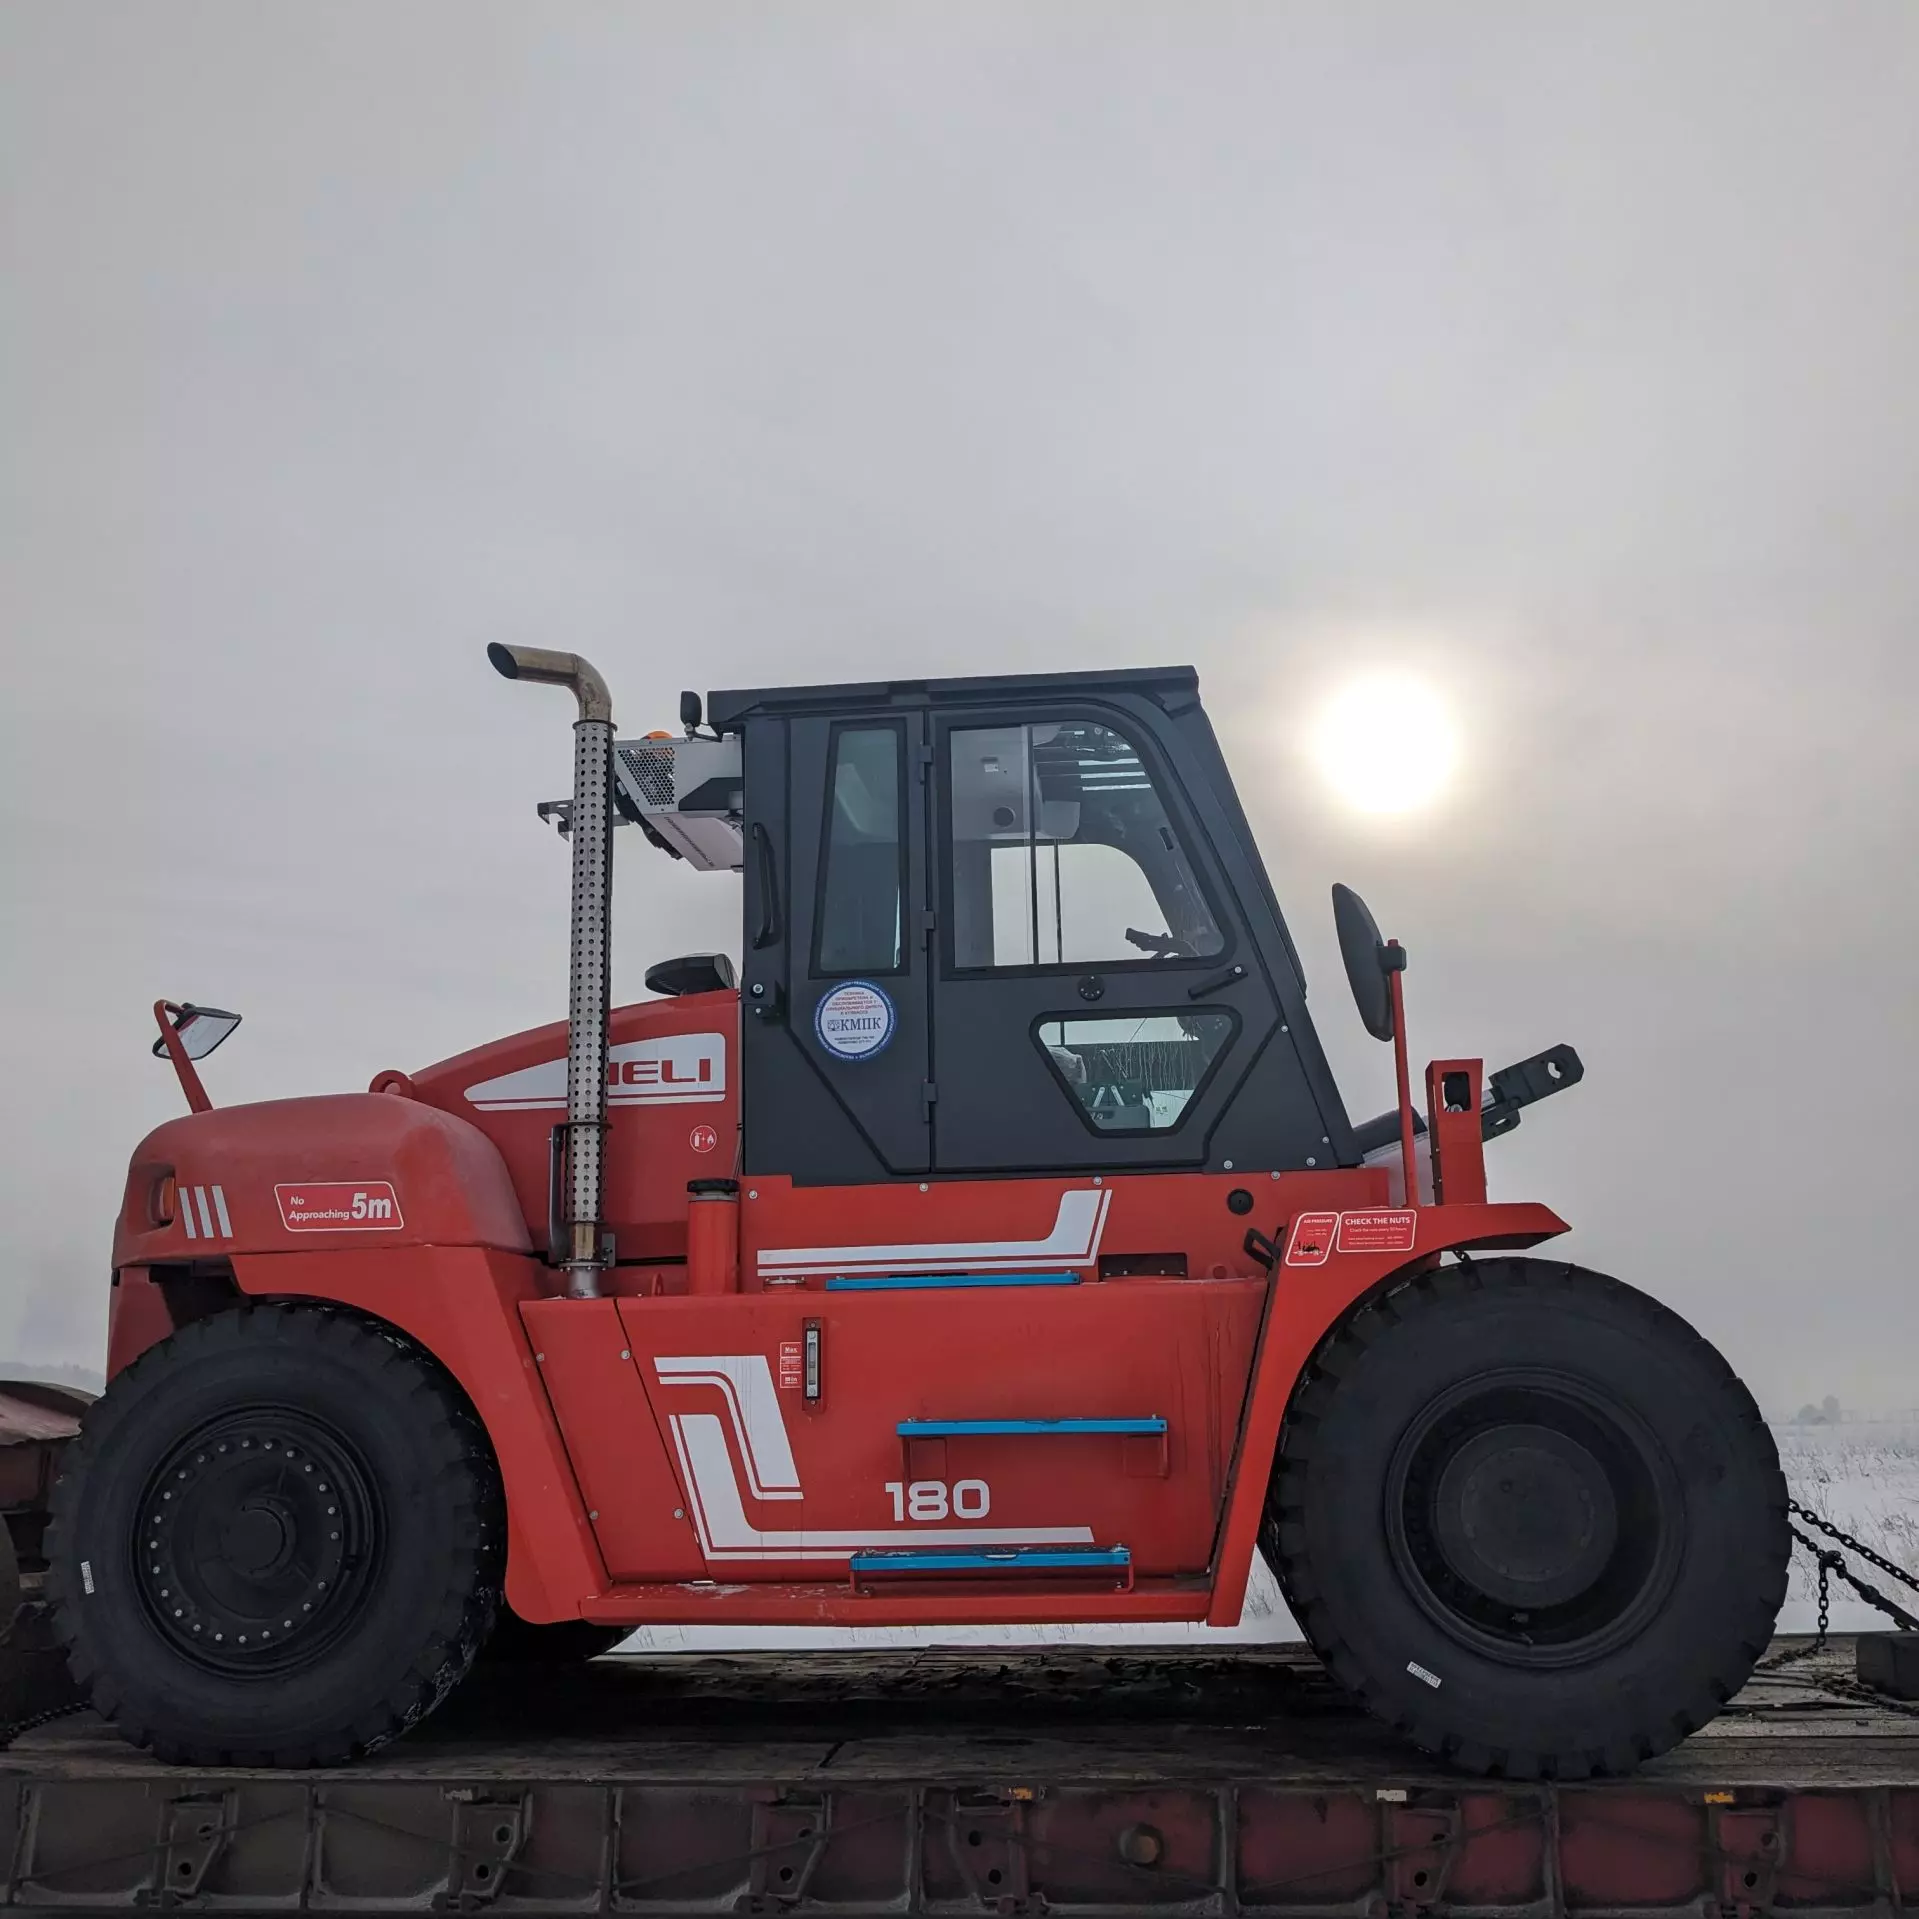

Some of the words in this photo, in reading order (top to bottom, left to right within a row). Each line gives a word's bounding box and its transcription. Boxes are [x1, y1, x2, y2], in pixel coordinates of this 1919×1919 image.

[841, 1017, 881, 1030] КМПК
[609, 1058, 711, 1085] ELI
[289, 1209, 349, 1221] Approaching
[352, 1192, 391, 1219] 5m
[290, 1196, 305, 1205] No
[885, 1479, 990, 1521] 180
